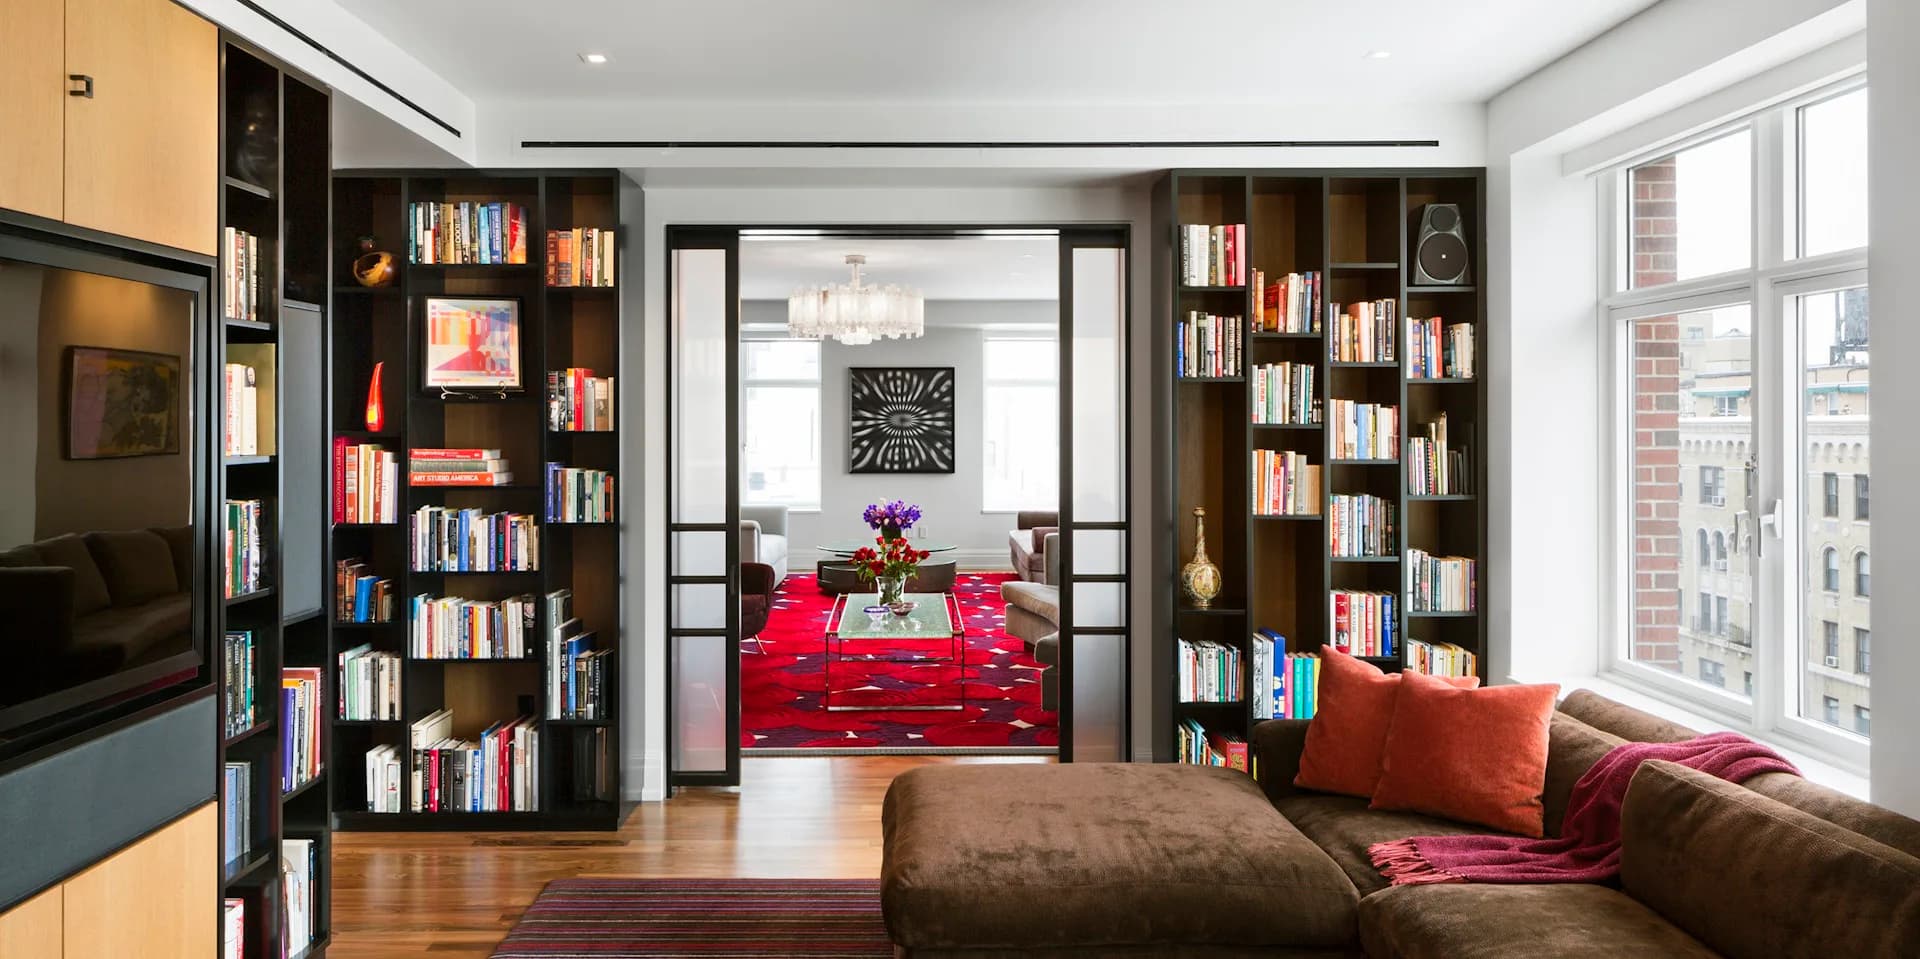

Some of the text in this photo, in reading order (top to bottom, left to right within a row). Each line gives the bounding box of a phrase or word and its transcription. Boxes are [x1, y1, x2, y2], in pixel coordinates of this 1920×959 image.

[413, 474, 478, 482] ART STUDIO AMERICA
